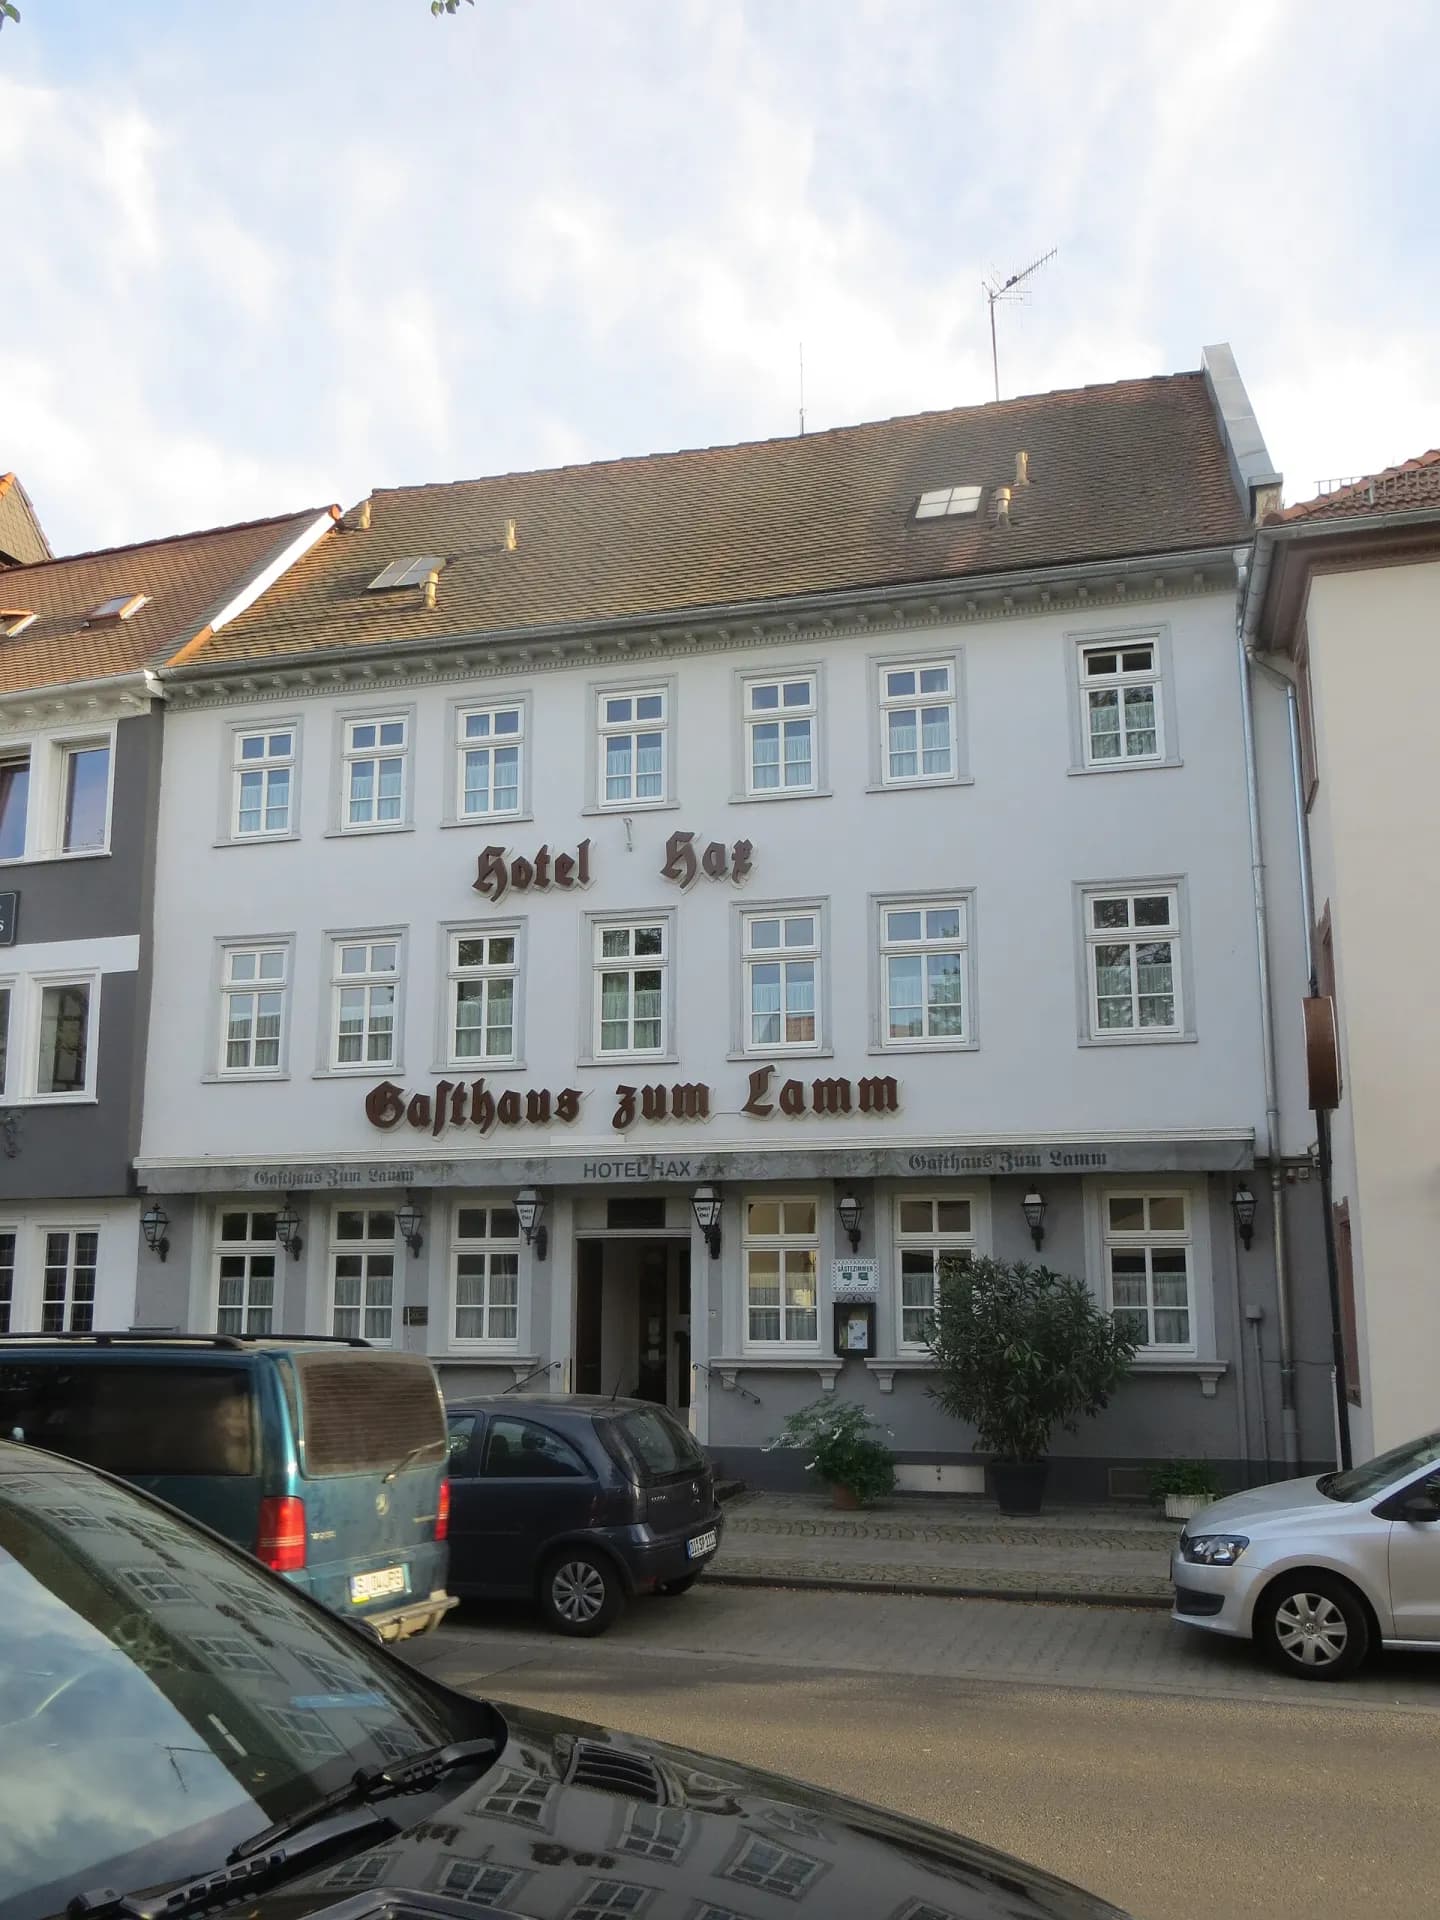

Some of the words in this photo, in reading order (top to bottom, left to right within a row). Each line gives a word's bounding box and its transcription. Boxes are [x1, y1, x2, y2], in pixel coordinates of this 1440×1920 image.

[472, 838, 591, 902] Hotel
[612, 1083, 710, 1129] zum
[741, 1064, 898, 1117] Lamm
[583, 1162, 649, 1179] HOTEL
[654, 1160, 691, 1177] HAX
[999, 1151, 1042, 1172] Zum
[1050, 1150, 1107, 1167] Lamm
